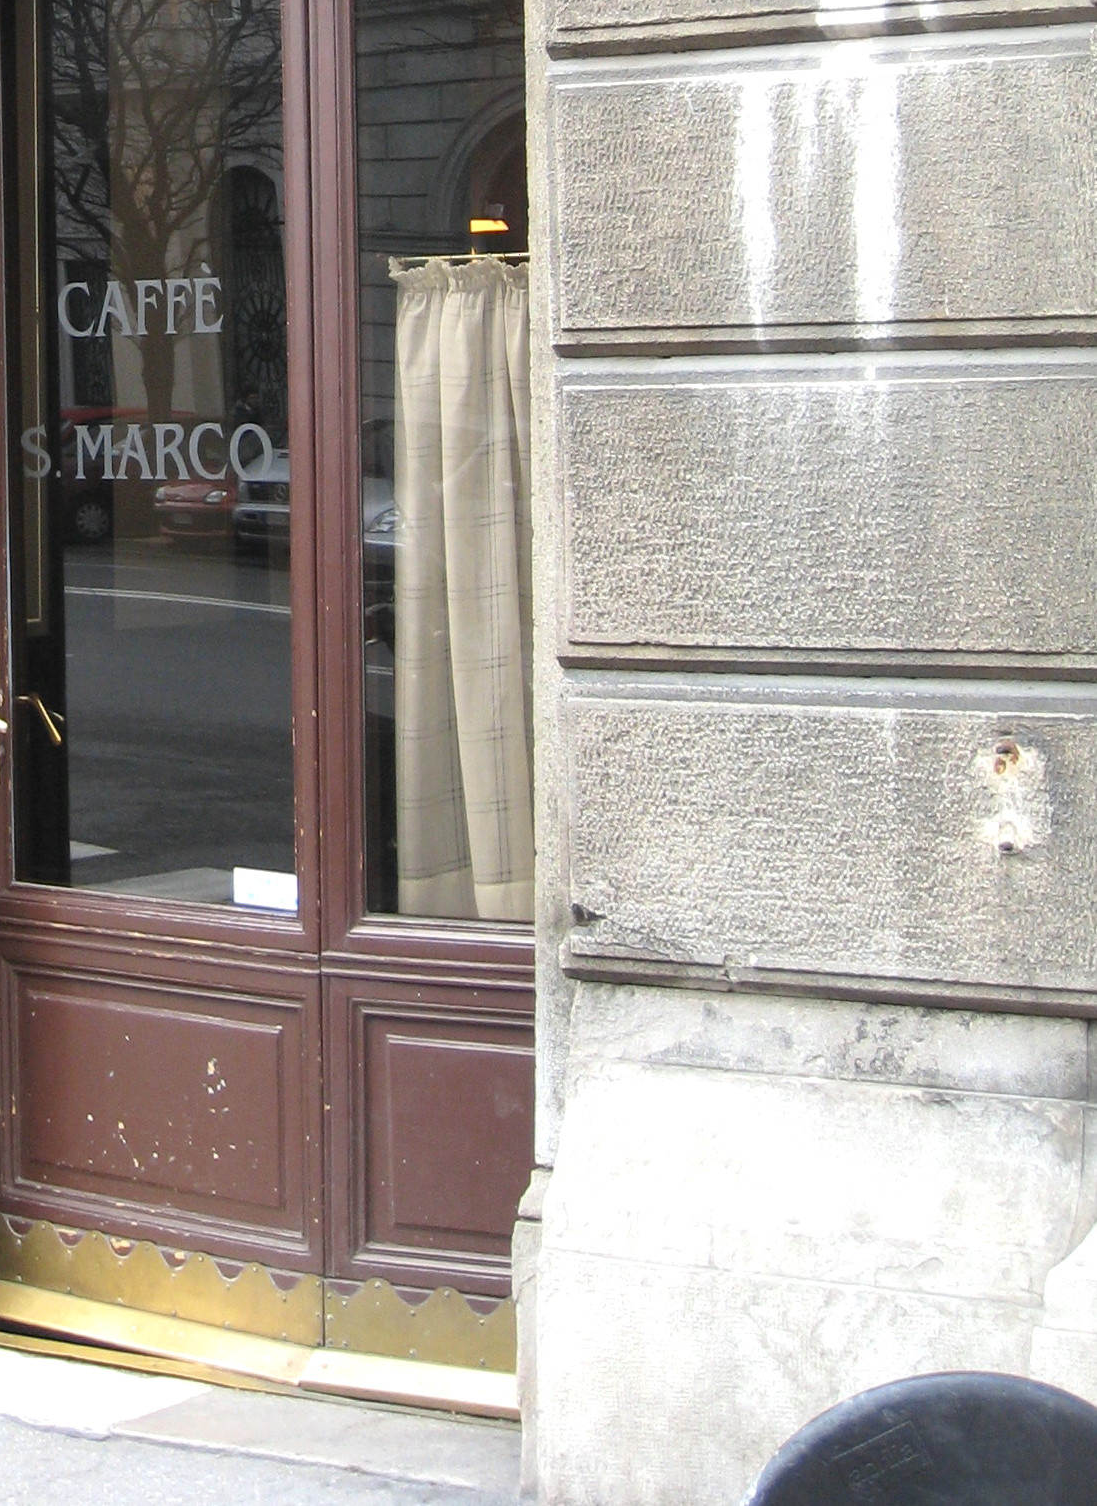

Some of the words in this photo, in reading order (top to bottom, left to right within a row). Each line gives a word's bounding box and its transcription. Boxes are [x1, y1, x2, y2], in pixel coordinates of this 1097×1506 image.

[57, 261, 224, 337] CAFFÈ
[20, 424, 62, 479] S.
[75, 423, 273, 480] MARCO
